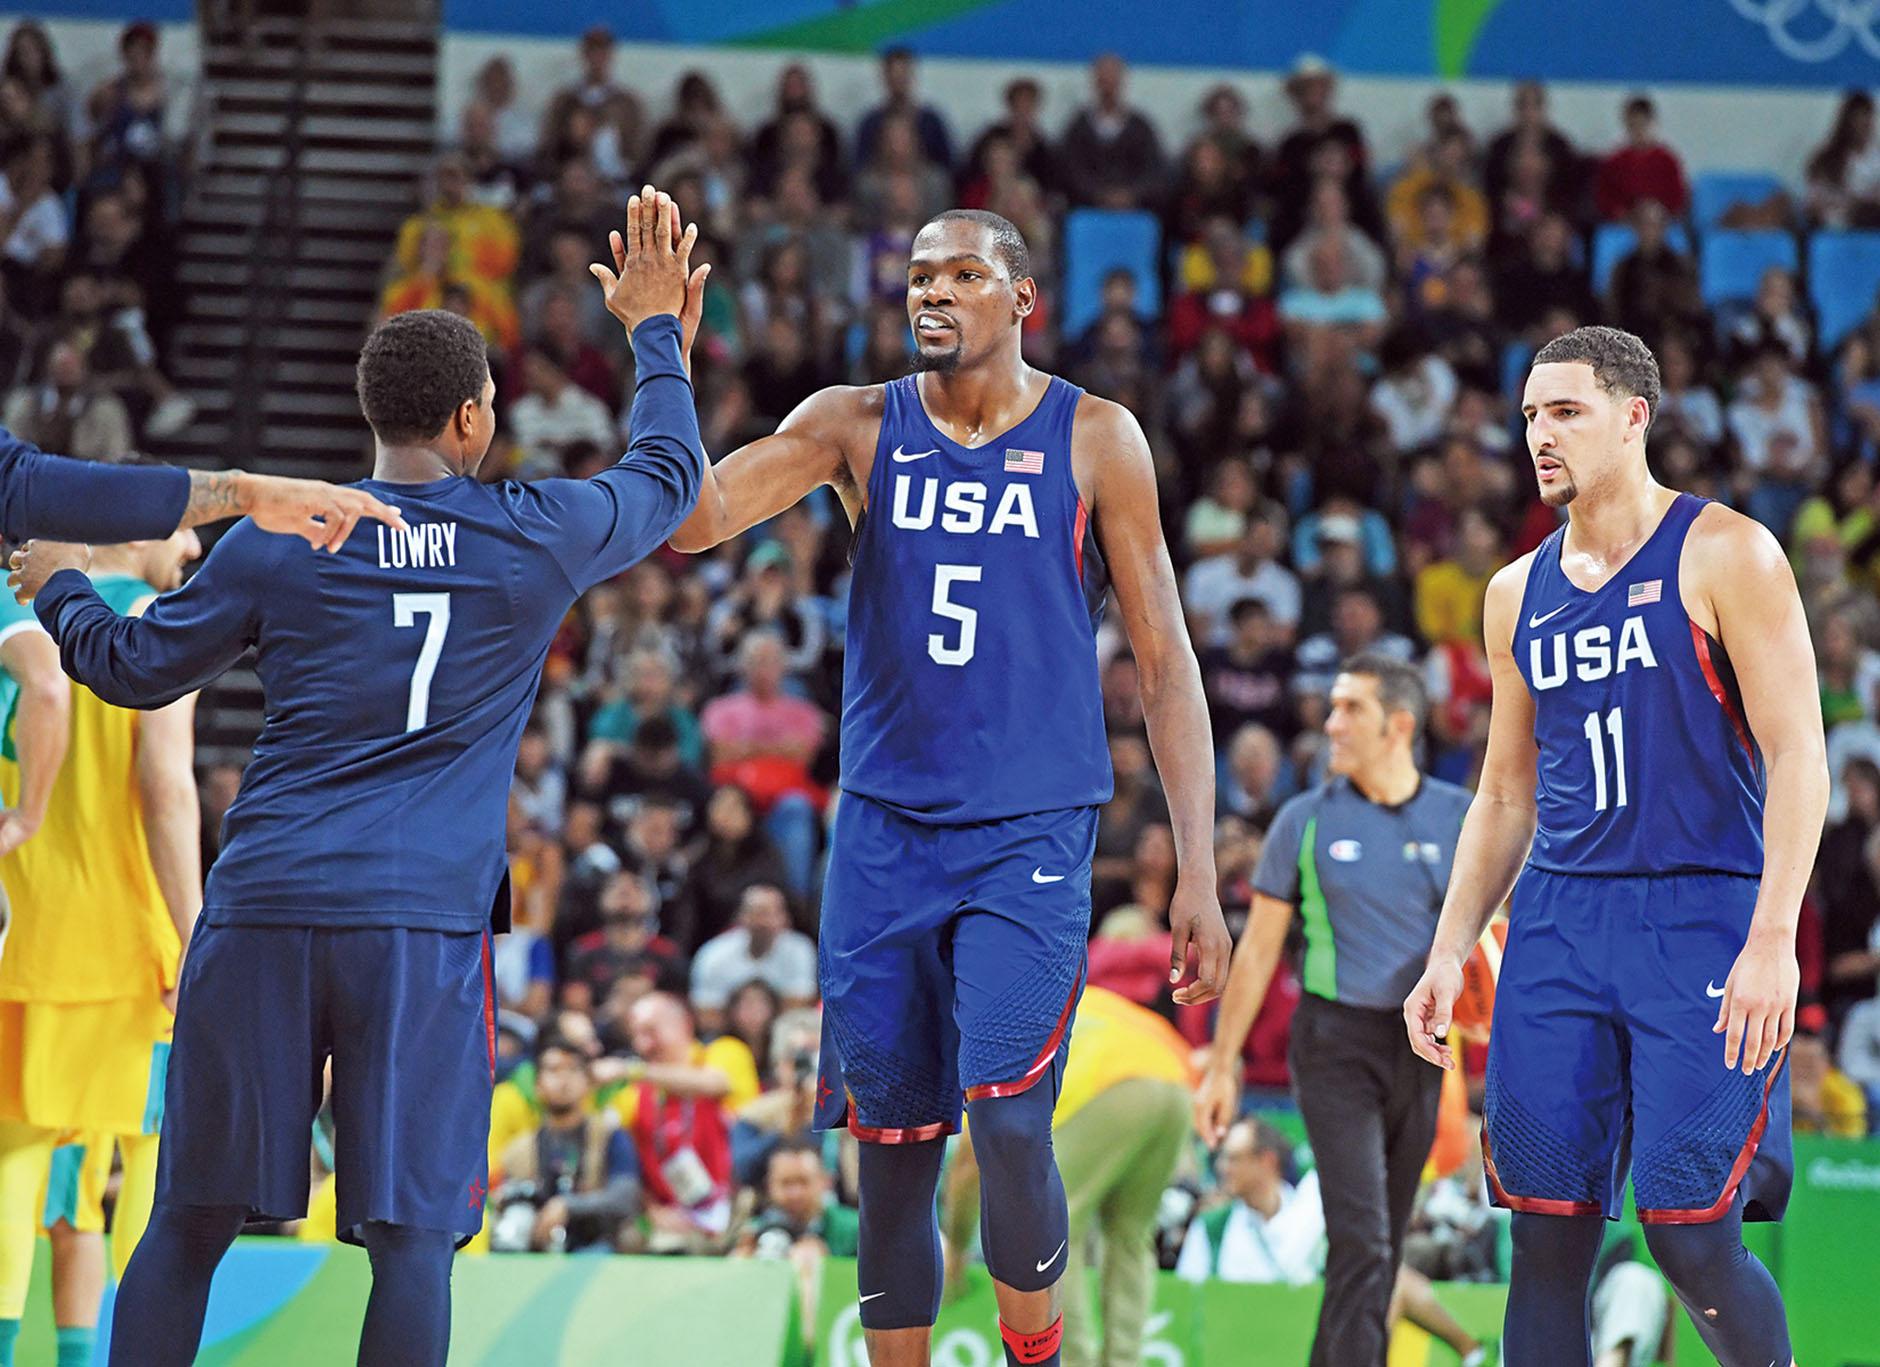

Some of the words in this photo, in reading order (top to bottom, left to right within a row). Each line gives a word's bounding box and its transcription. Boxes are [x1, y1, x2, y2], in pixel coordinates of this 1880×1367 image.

[377, 522, 457, 569] LOWRY
[892, 474, 1040, 538] USA
[928, 563, 983, 667] 5
[1530, 615, 1658, 691] USA
[393, 591, 451, 734] 7
[1584, 706, 1628, 811] 11
